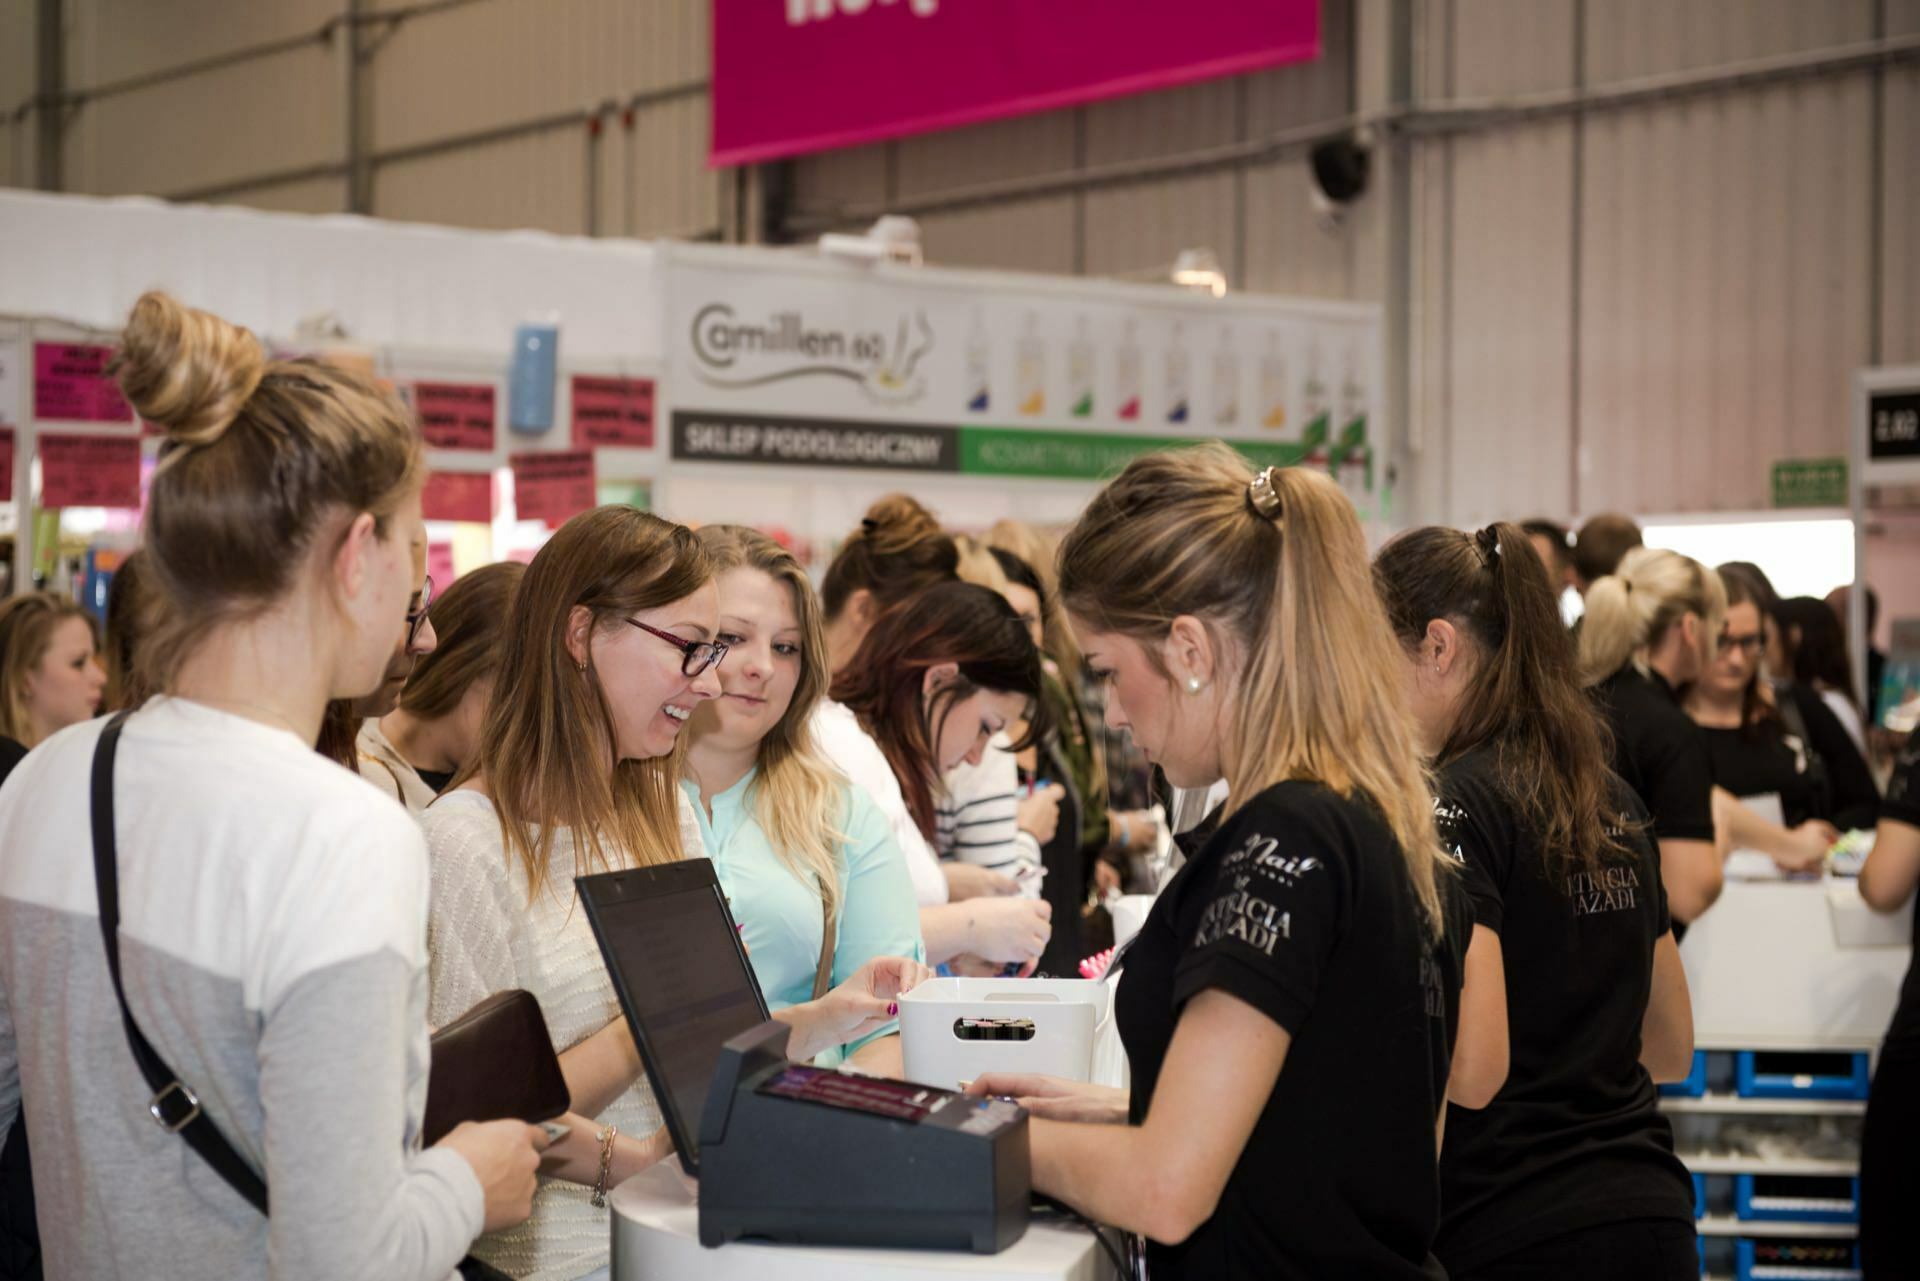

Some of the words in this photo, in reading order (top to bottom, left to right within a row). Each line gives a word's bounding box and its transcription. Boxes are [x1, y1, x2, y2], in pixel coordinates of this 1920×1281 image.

[691, 302, 846, 369] Camillen
[686, 422, 758, 455] SKLEP
[760, 426, 943, 464] PODOLOGICZNY
